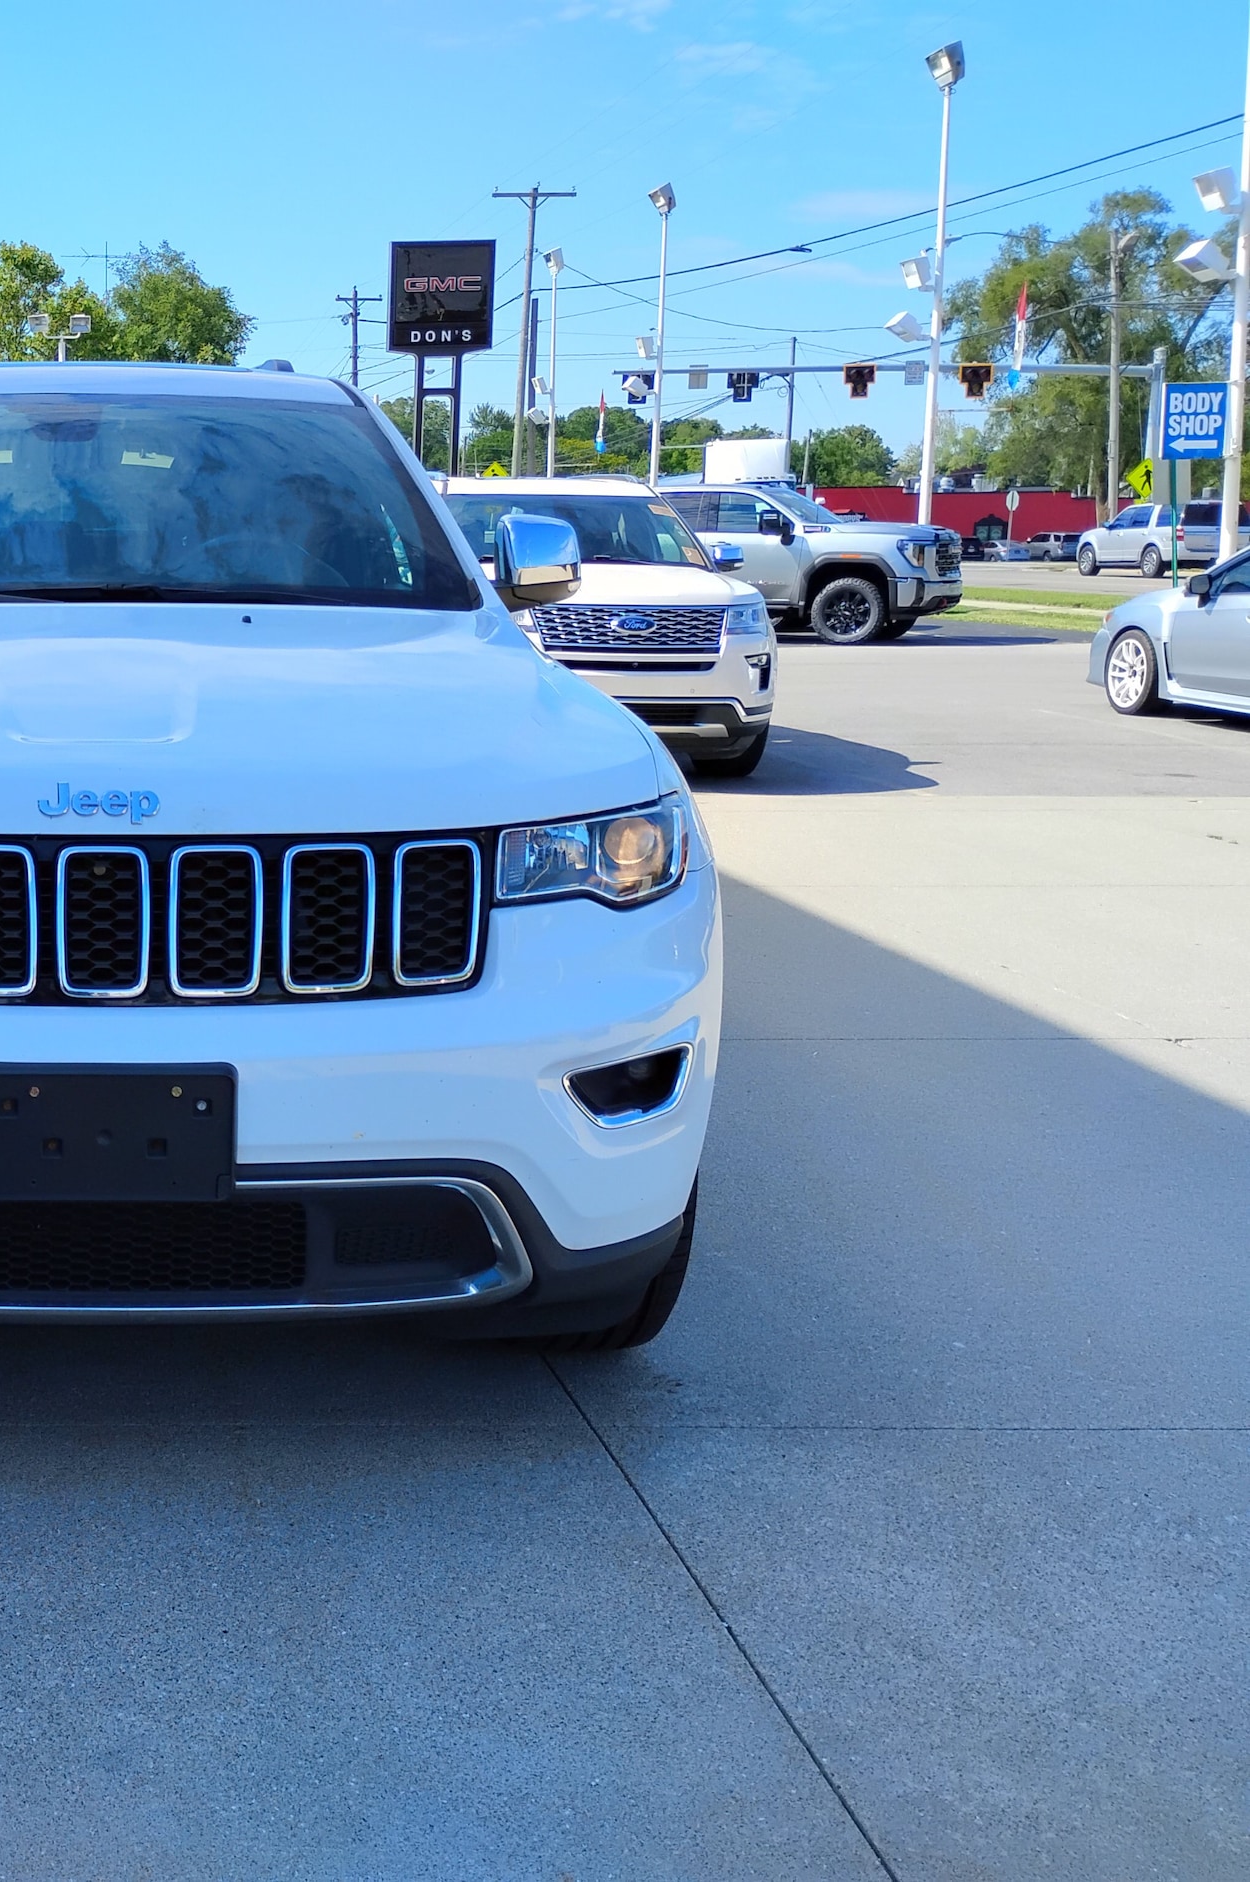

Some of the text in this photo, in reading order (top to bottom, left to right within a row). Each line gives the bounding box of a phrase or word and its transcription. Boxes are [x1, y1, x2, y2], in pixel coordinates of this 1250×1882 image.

[404, 276, 481, 292] GMC
[410, 329, 471, 343] DON'S
[1169, 392, 1223, 413] BODY
[1168, 414, 1222, 436] SHOP
[624, 619, 647, 629] Ford
[38, 782, 160, 825] Jeep
